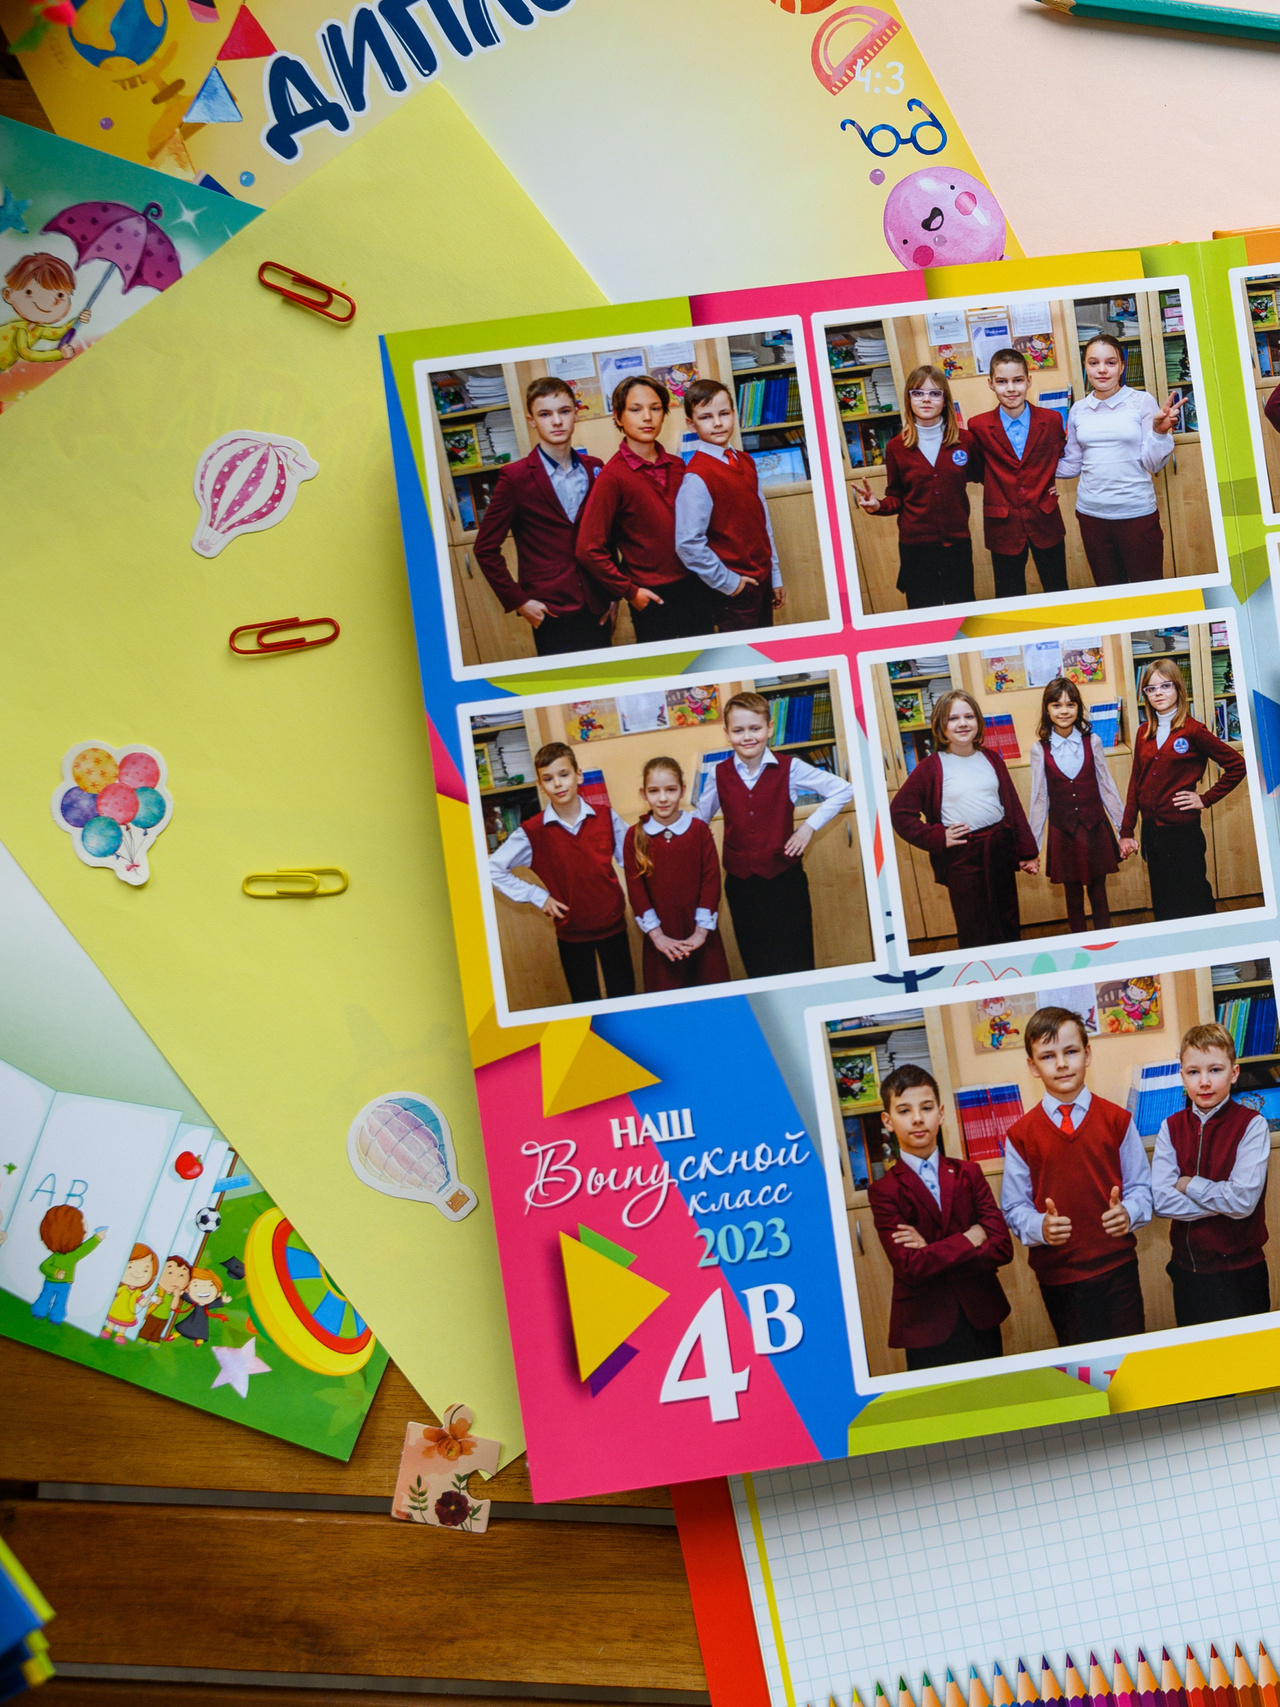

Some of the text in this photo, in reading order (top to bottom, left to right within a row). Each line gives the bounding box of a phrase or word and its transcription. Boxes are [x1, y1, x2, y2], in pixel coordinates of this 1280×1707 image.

[264, 0, 573, 161] ДИПЛ
[855, 58, 905, 95] 4:3
[609, 1107, 696, 1149] НАШ
[521, 1130, 811, 1229] Выпускной
[688, 1183, 793, 1217] класс
[694, 1217, 791, 1268] 2023
